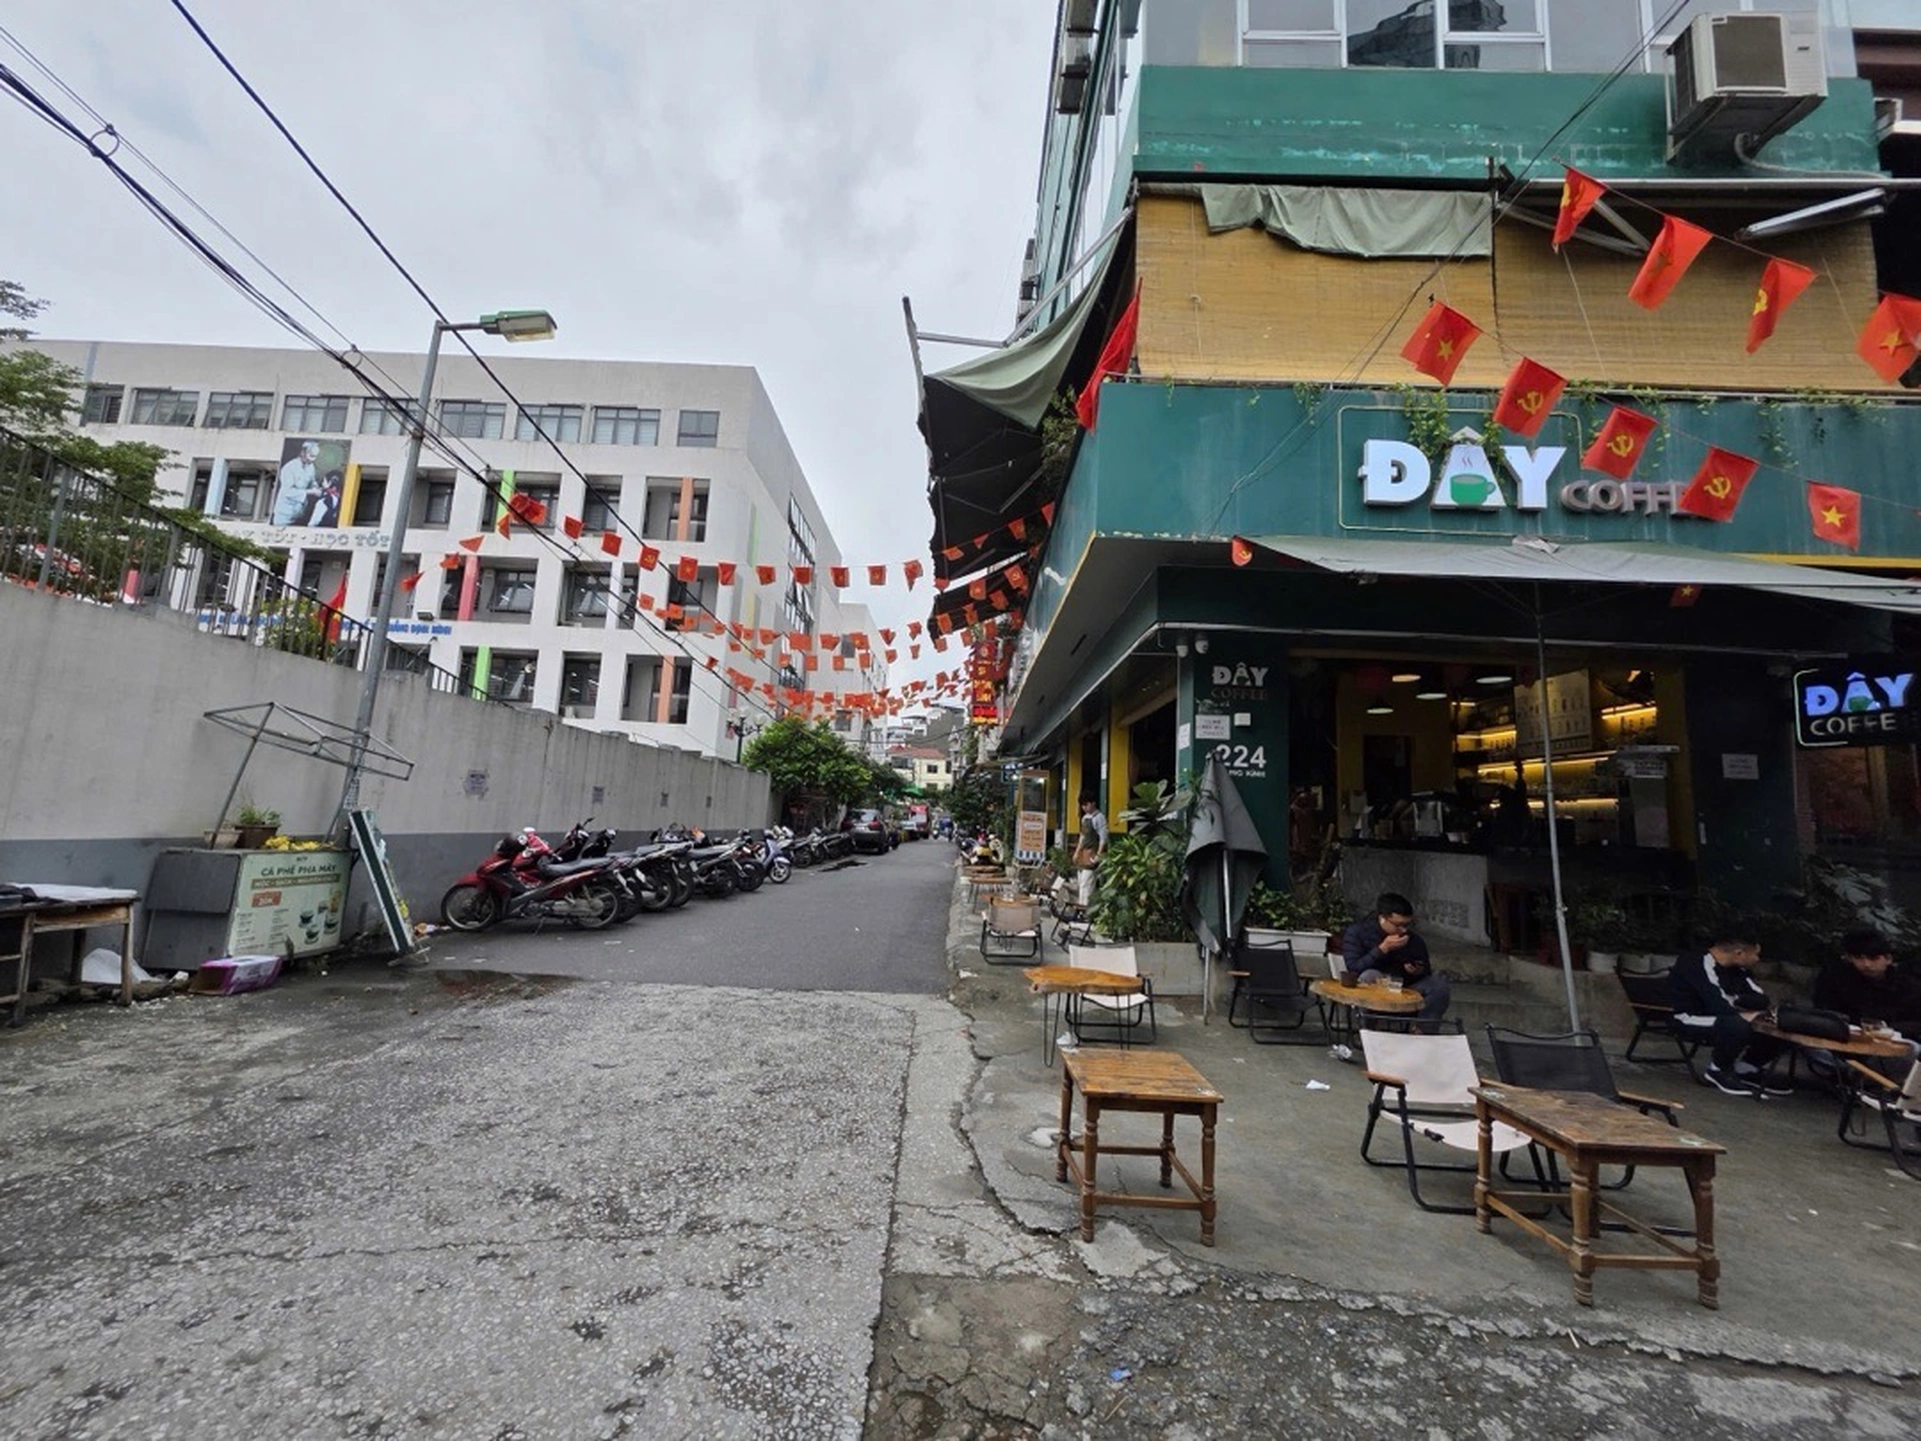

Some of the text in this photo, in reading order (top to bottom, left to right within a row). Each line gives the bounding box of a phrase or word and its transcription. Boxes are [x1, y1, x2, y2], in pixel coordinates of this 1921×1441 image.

[1357, 425, 1567, 511] ĐÂY
[1211, 662, 1269, 687] ĐÂY
[1804, 671, 1914, 717] ĐÂY
[1216, 744, 1267, 768] 224
